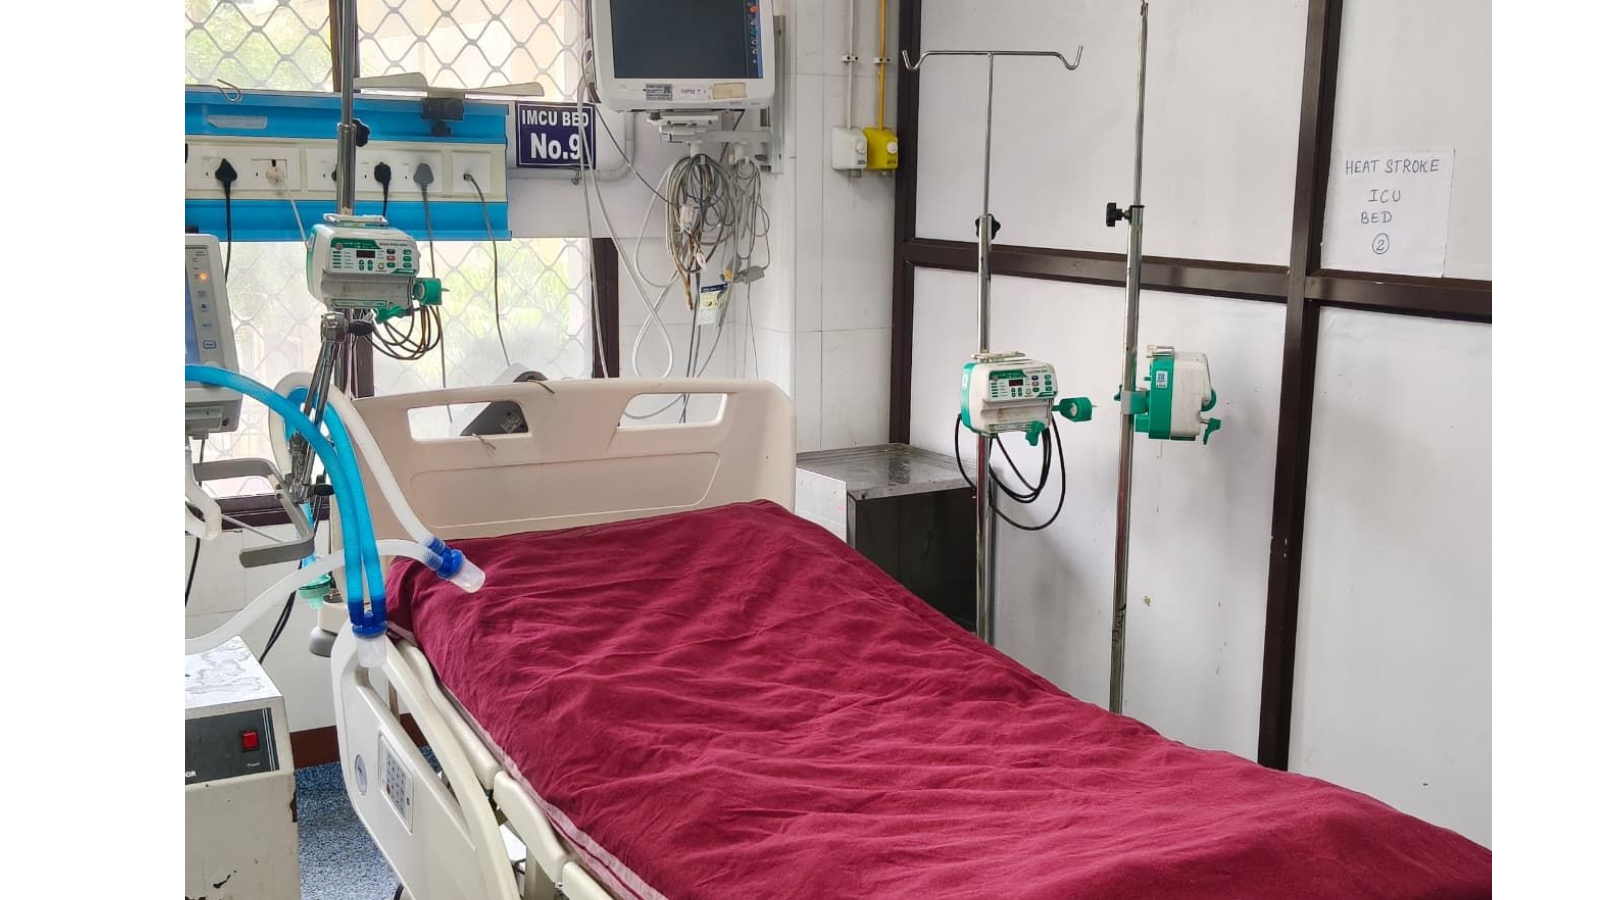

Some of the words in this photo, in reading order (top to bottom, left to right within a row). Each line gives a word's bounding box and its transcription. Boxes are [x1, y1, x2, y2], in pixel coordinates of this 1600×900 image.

[522, 109, 557, 126] IMCU
[562, 111, 589, 127] BED
[530, 132, 581, 160] No.9
[1345, 159, 1379, 175] HEAT
[1384, 158, 1440, 174] STROKE
[1368, 189, 1401, 203] ICU
[1360, 210, 1392, 225] BED
